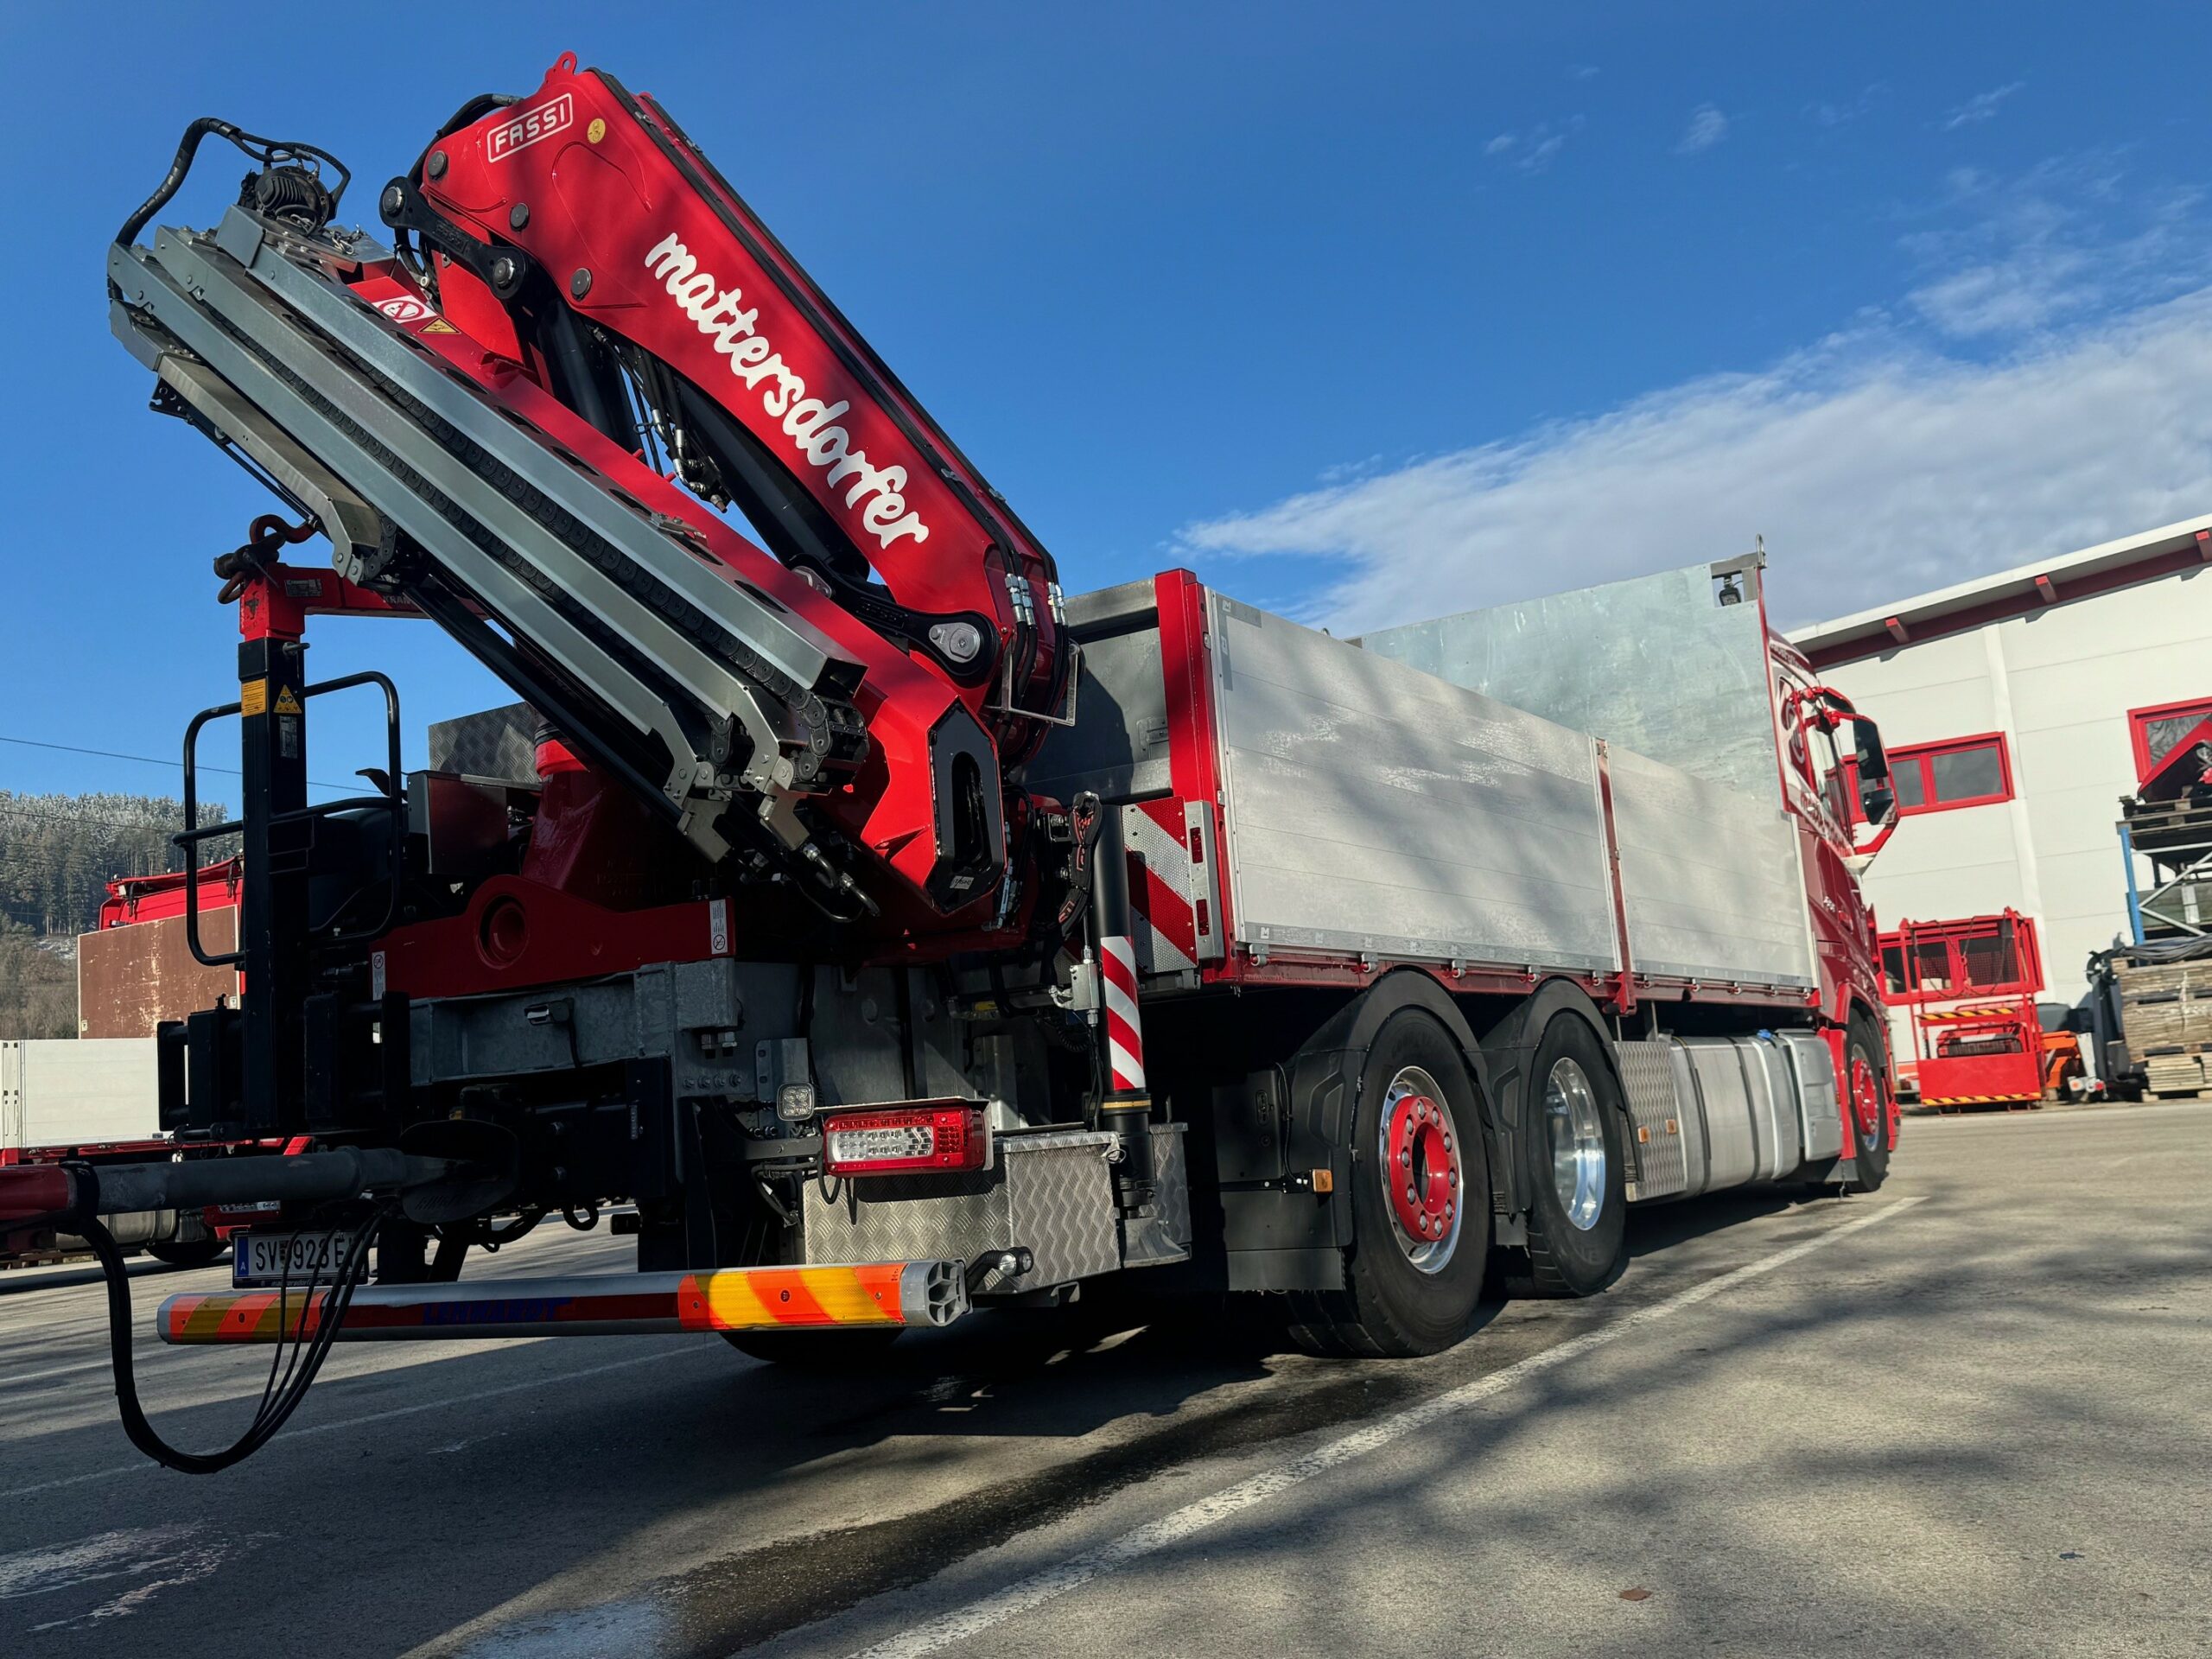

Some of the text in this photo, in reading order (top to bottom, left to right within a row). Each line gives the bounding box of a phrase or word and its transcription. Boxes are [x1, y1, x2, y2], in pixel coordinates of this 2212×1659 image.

[495, 103, 566, 153] FASSI
[645, 232, 930, 550] mattersdorfer
[255, 1242, 277, 1271] SV
